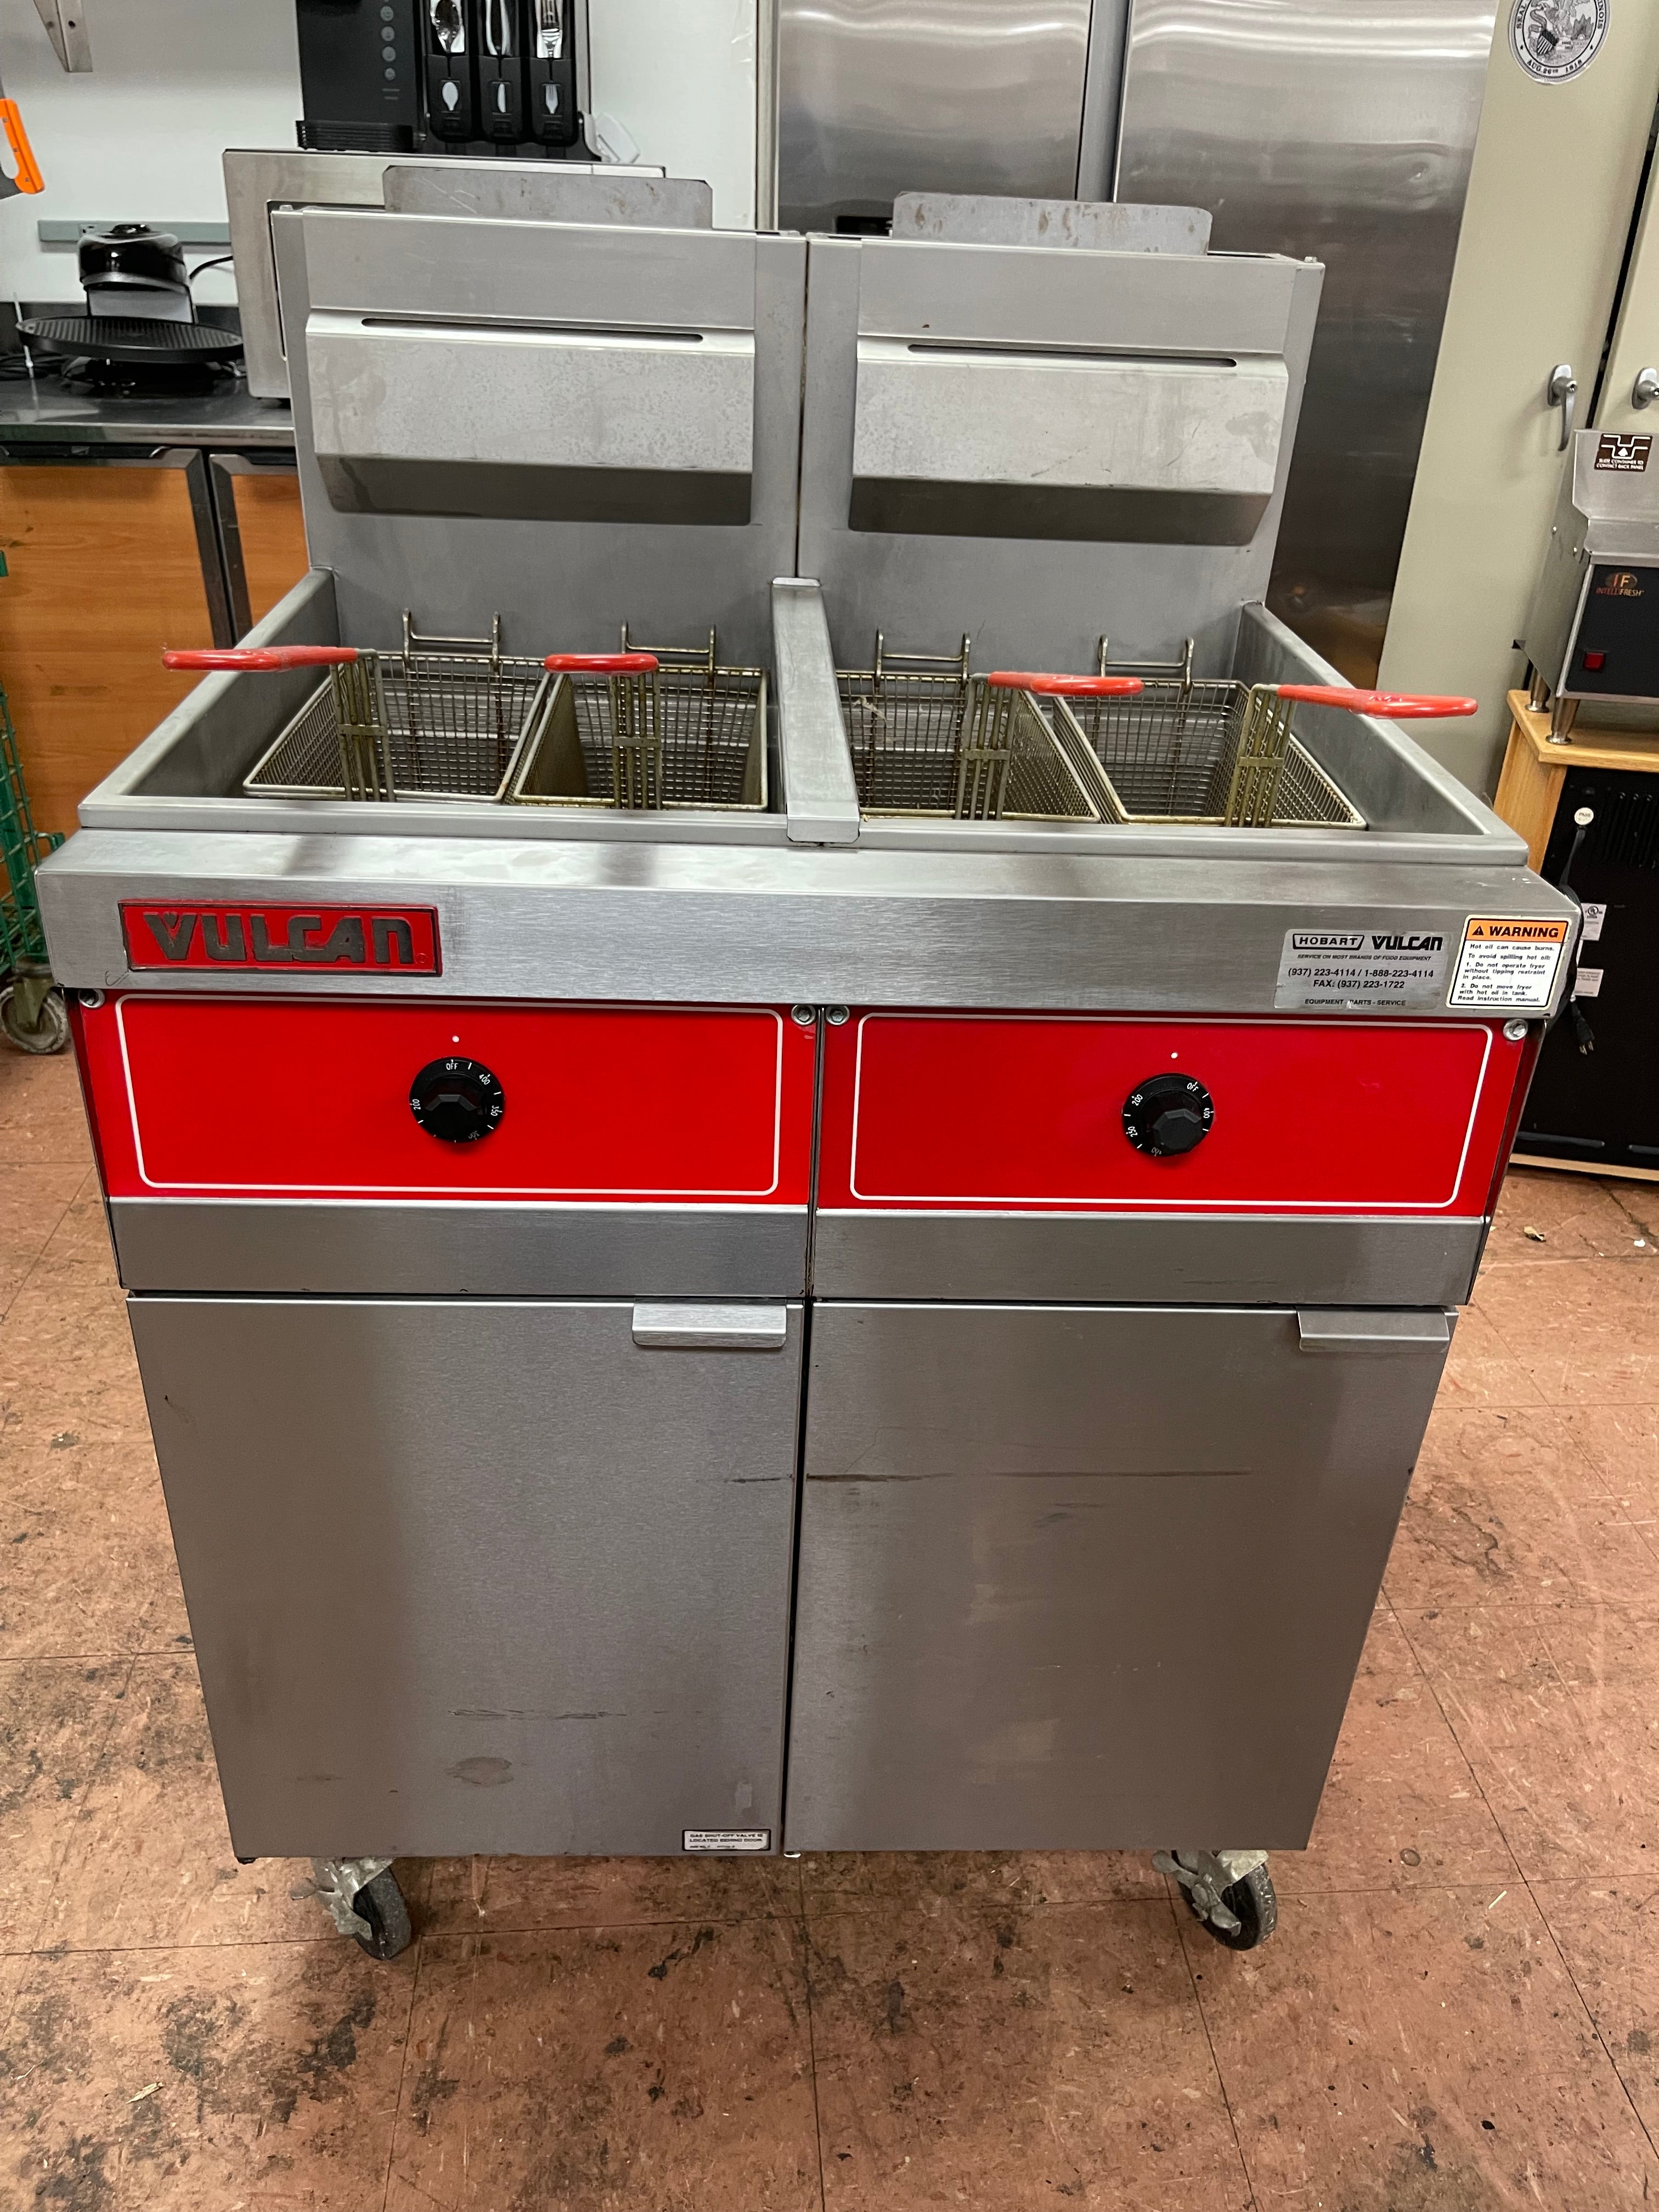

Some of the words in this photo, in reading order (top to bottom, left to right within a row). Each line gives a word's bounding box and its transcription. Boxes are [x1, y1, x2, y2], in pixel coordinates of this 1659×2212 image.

[142, 911, 416, 964] VULCAN
[1489, 926, 1559, 938] WARNING
[1299, 937, 1358, 945] HOBART
[1372, 935, 1443, 951] VULCAN
[1288, 968, 1311, 977] (937)
[1314, 968, 1356, 977] 223-4114
[1338, 980, 1361, 989] (937)
[479, 1074, 490, 1085] 400
[1187, 1082, 1199, 1092] OFF
[412, 1098, 421, 1110] 200
[1131, 1094, 1143, 1106] 200
[490, 1105, 500, 1116] 350
[1127, 1126, 1138, 1137] 250
